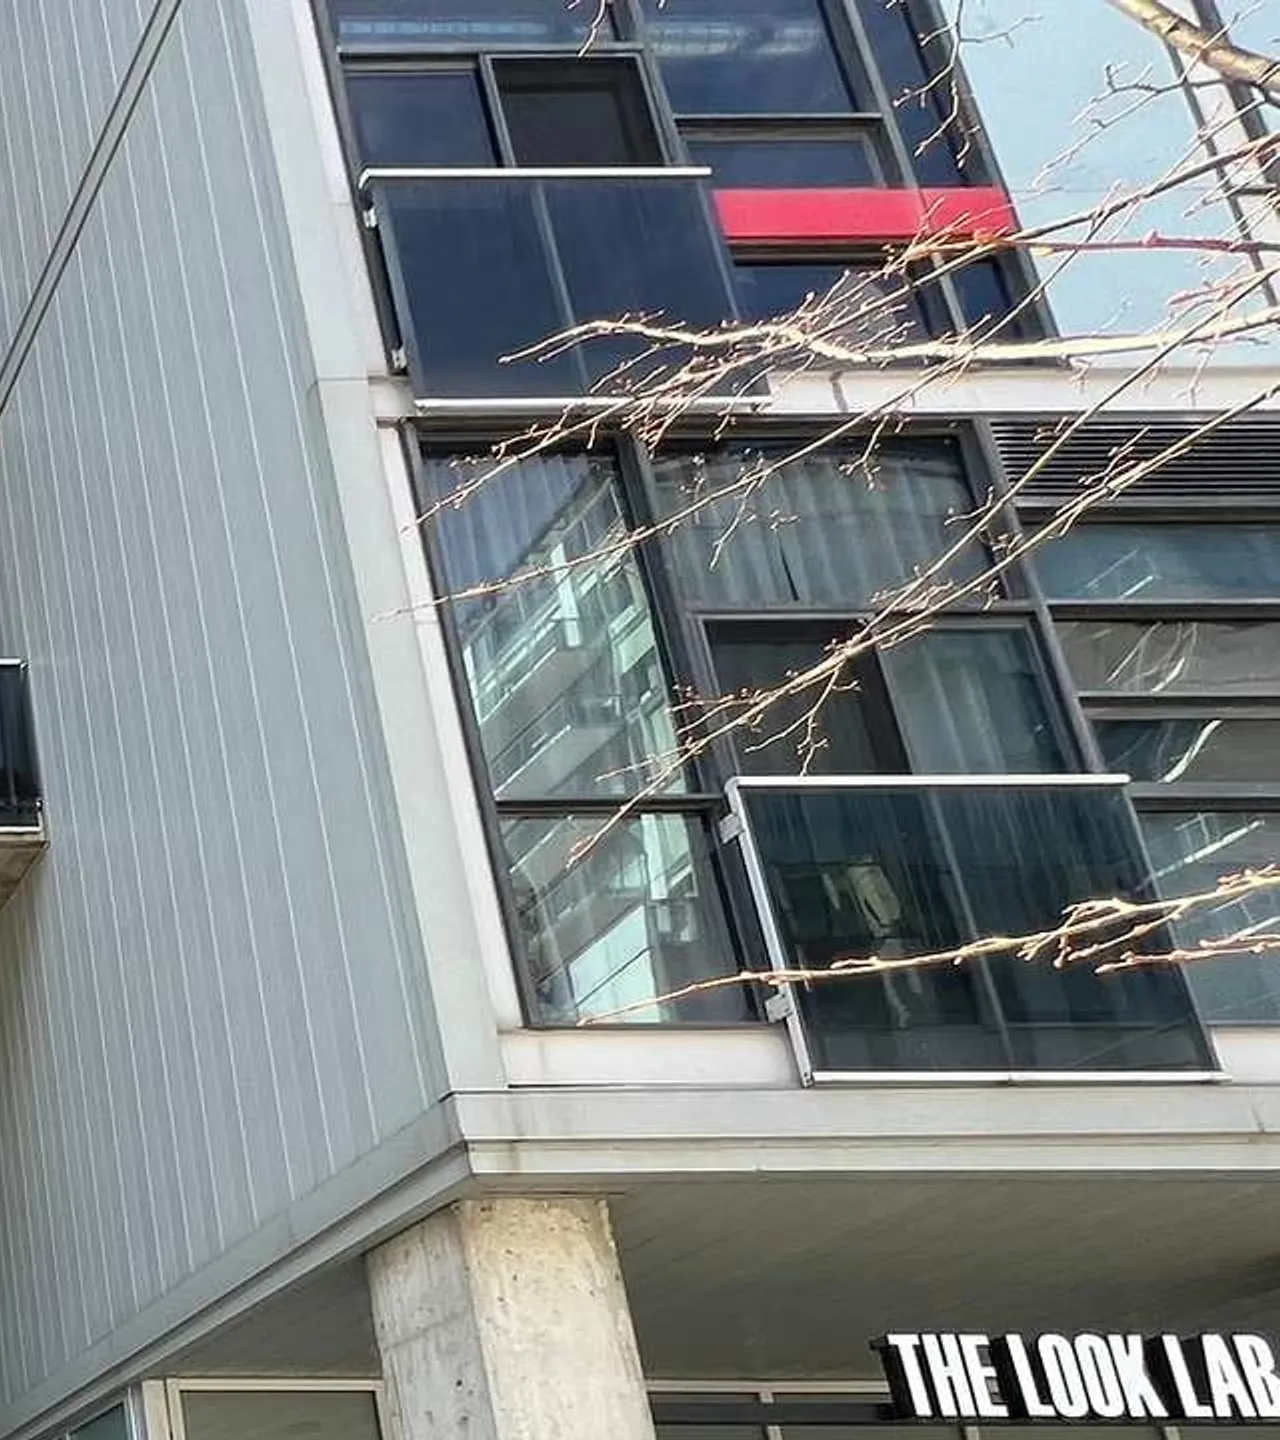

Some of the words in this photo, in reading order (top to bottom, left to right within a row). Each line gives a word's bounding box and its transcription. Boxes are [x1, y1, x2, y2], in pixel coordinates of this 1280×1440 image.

[887, 1333, 1009, 1418] THE
[1005, 1333, 1169, 1418] LOOK
[1161, 1333, 1280, 1418] LAB
